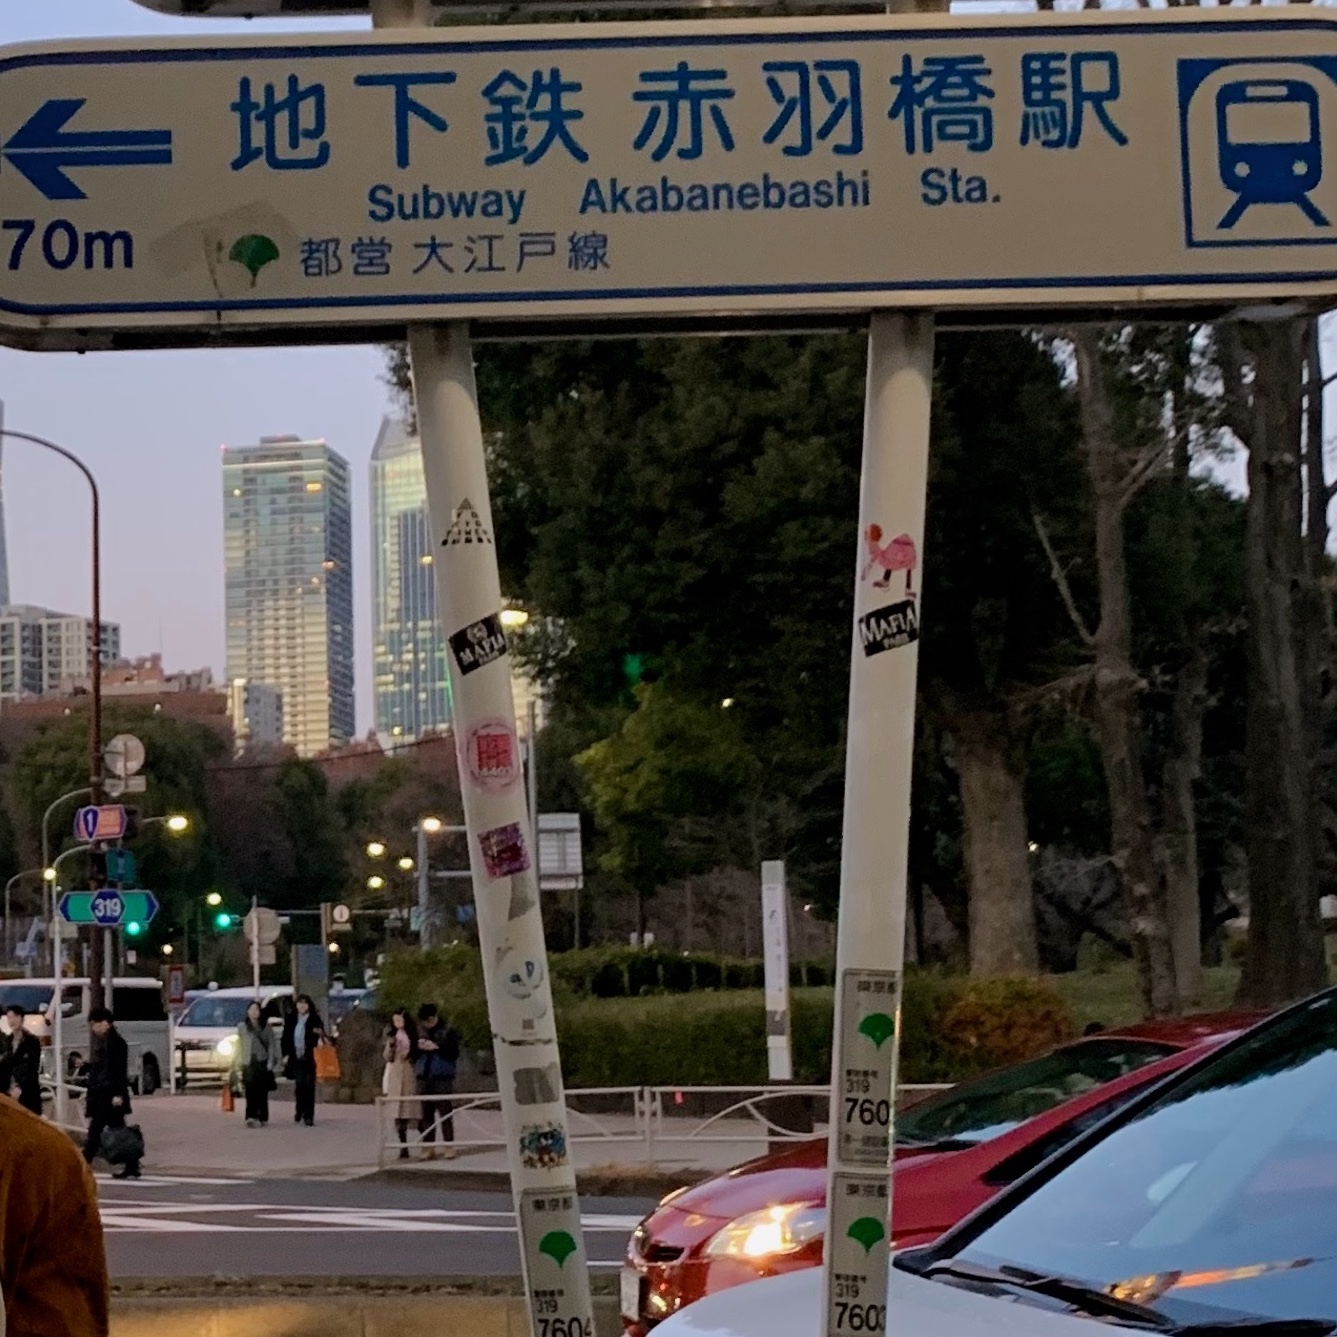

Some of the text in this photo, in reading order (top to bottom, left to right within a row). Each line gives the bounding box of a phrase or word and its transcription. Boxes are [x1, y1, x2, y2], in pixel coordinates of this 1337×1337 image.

[367, 166, 1002, 224] Subway Akabanebashi Sta.
[2, 218, 133, 270] 70m
[861, 607, 918, 646] MAFIA
[460, 633, 504, 666] MAFIA
[86, 811, 94, 832] 1
[94, 898, 122, 917] 319
[835, 1283, 860, 1298] 319
[537, 1300, 559, 1313] 319
